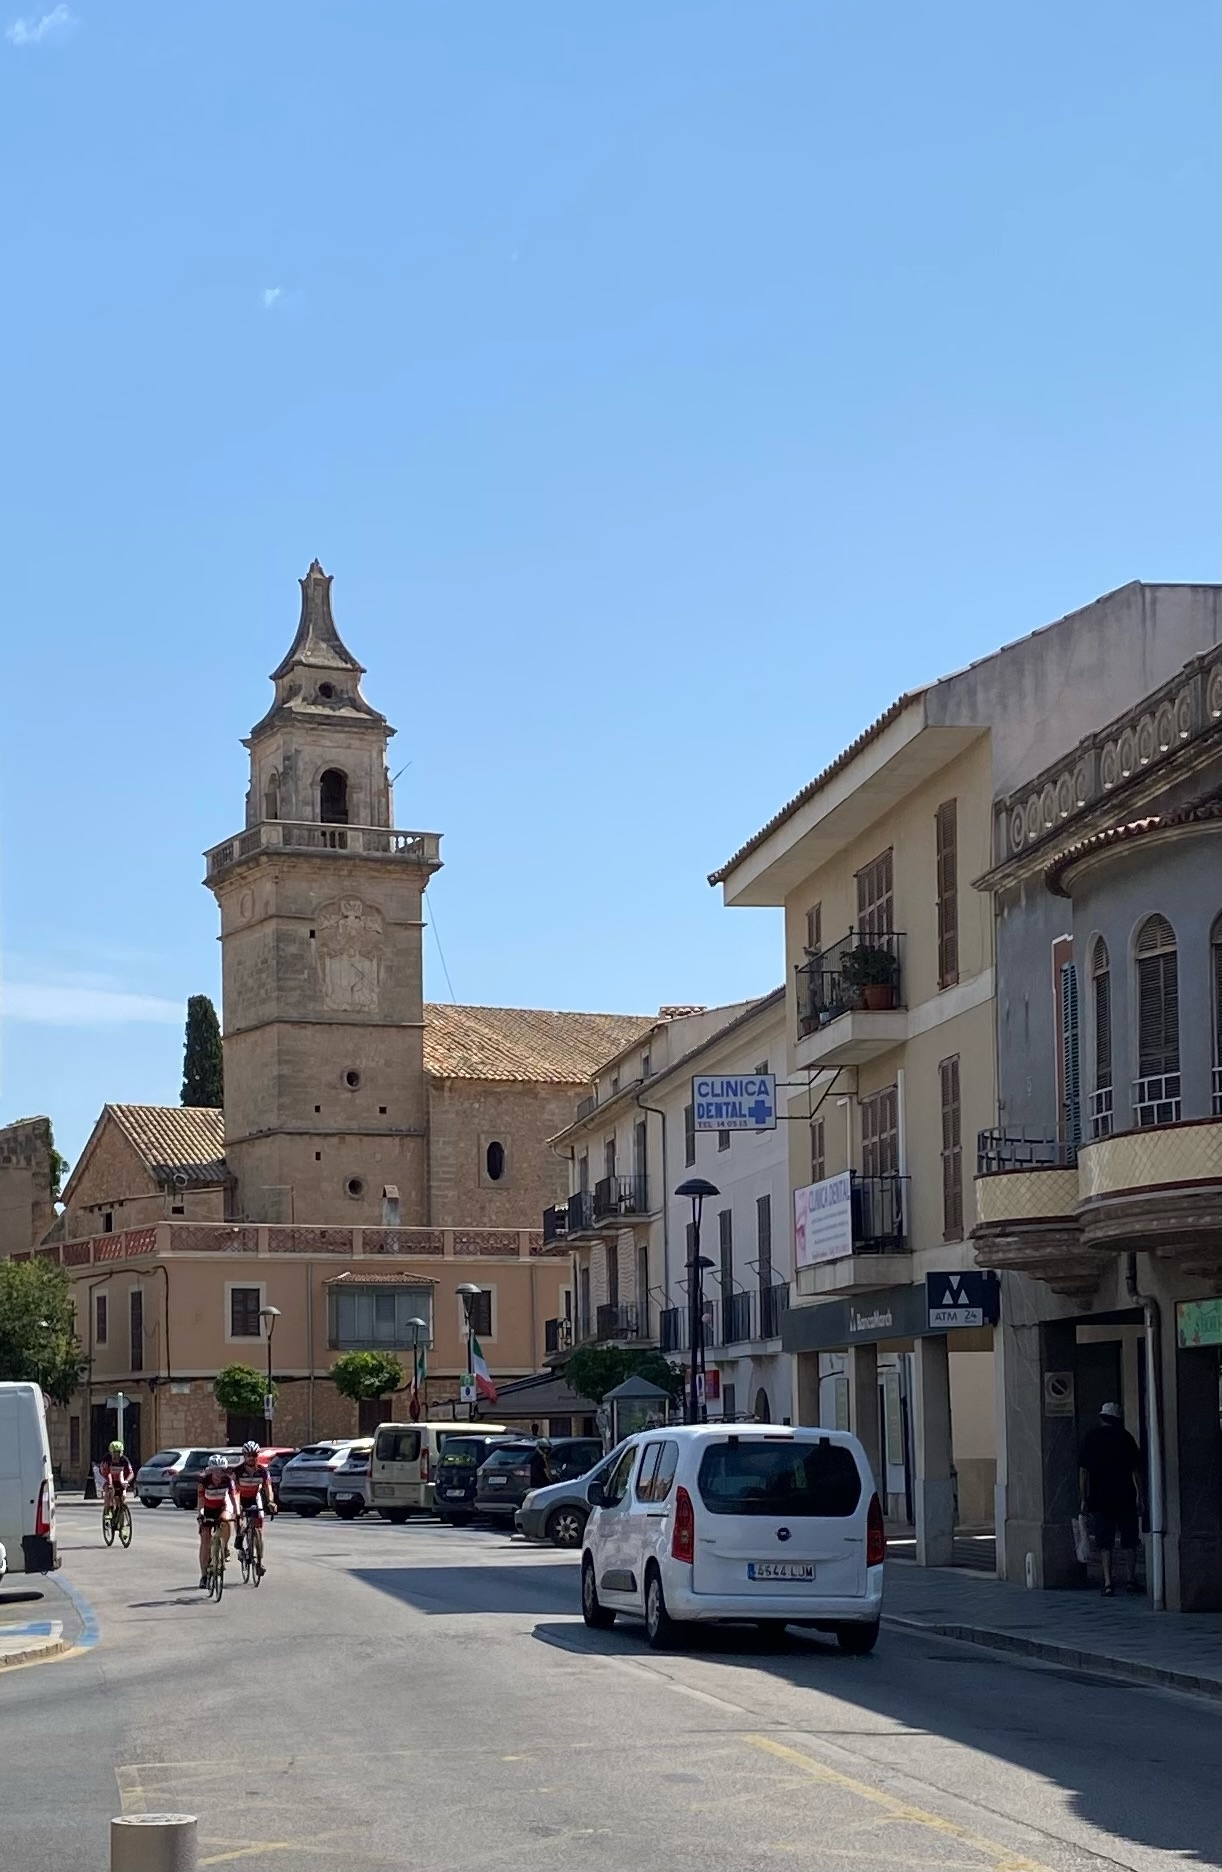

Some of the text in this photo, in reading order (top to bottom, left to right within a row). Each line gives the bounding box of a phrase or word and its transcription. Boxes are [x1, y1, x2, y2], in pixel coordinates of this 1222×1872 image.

[697, 1080, 770, 1098] CLINICA
[696, 1101, 747, 1119] DENTAL
[934, 1309, 978, 1321] ATM 24
